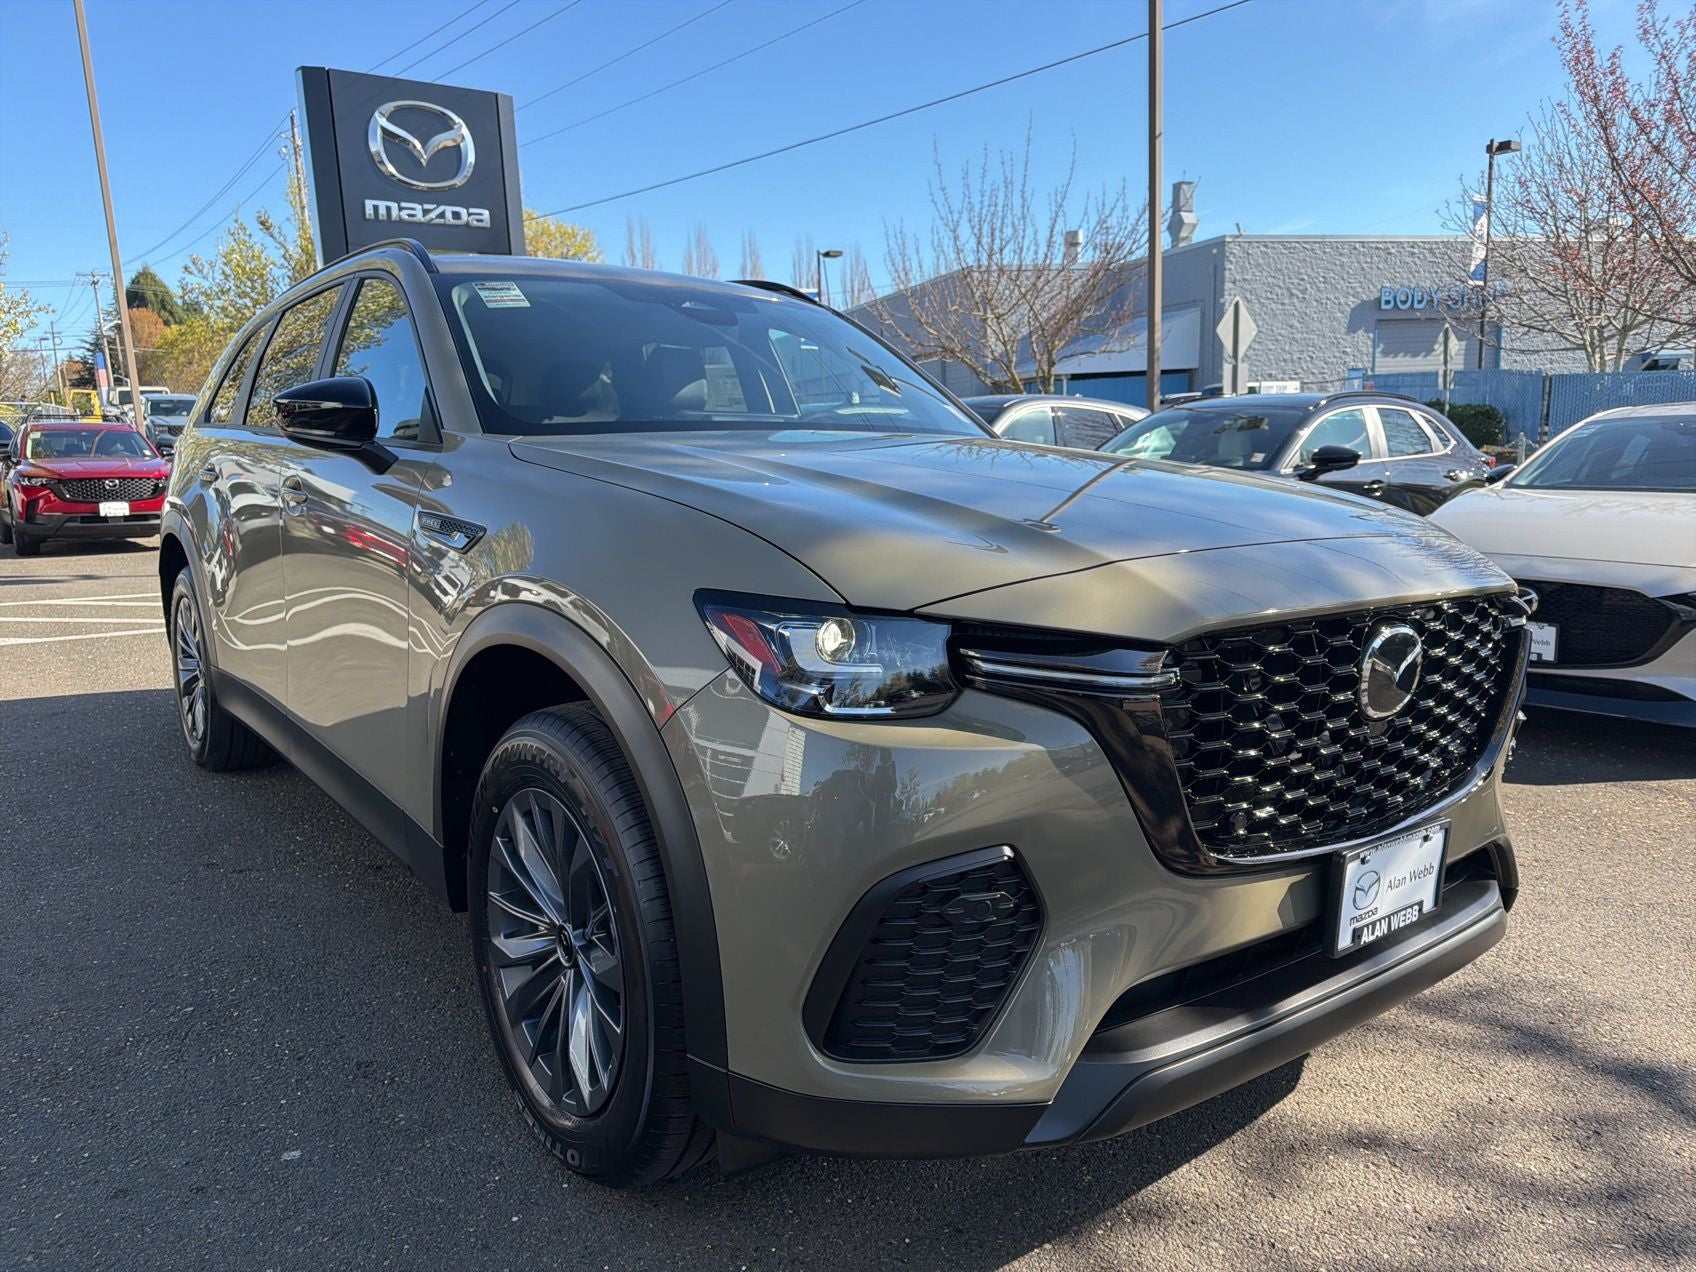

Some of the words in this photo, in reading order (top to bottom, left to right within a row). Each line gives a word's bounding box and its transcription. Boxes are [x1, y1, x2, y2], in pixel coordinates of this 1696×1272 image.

[364, 199, 491, 228] mazda
[1380, 286, 1441, 310] BODY
[1386, 876, 1406, 892] Alan
[1409, 863, 1434, 882] Webb
[1350, 907, 1379, 926] mazda
[1361, 917, 1389, 945] ALAN
[1391, 905, 1419, 931] WEBB
